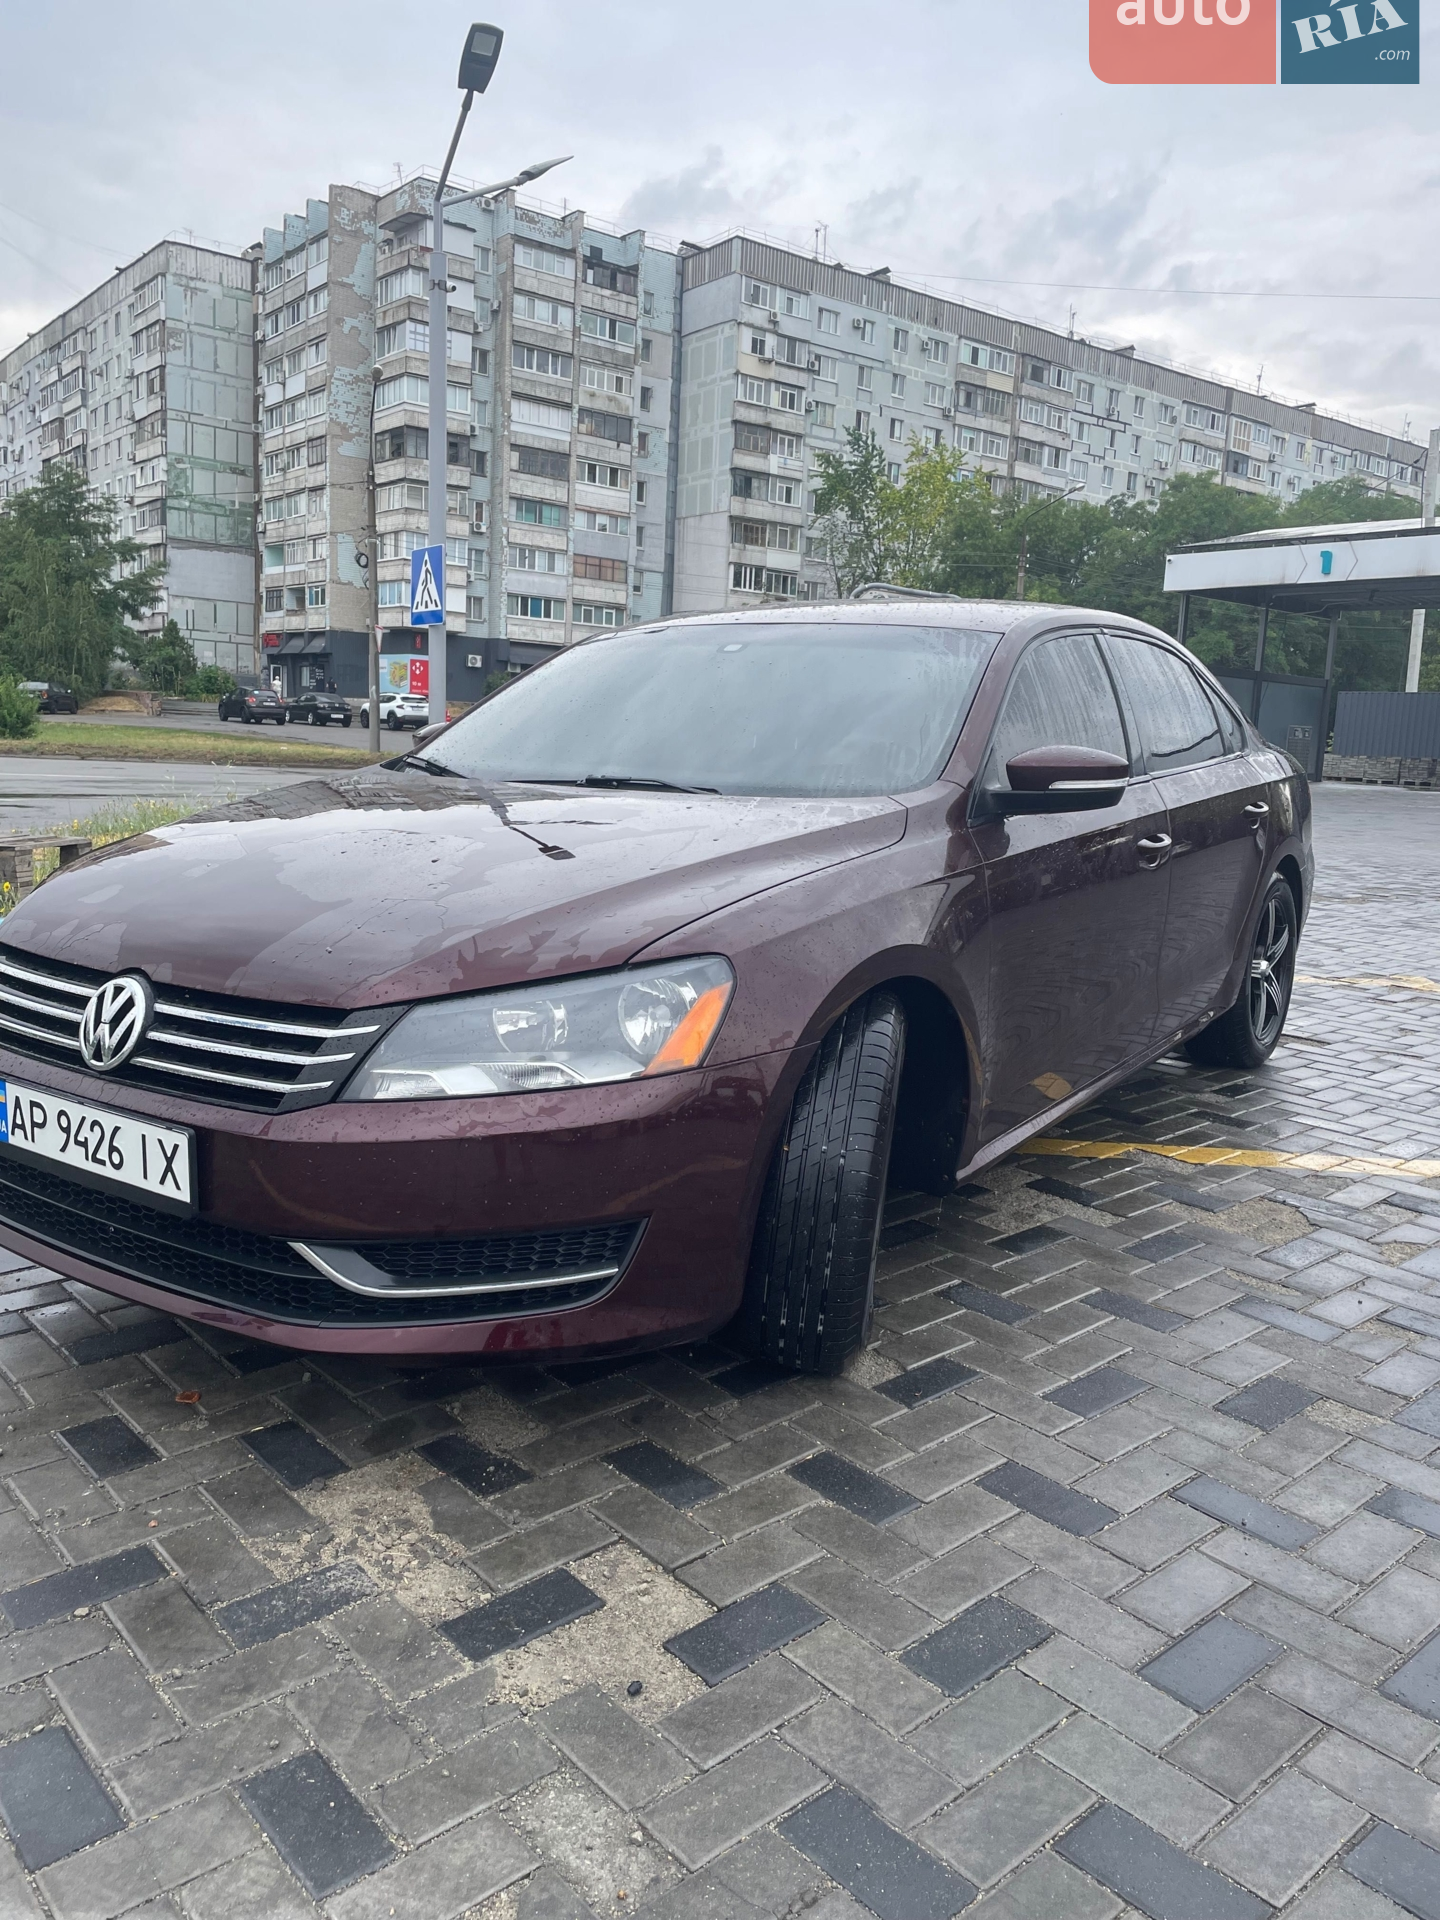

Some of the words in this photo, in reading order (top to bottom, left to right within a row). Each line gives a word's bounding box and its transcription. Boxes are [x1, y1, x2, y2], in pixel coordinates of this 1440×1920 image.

[1320, 550, 1333, 575] 1
[11, 1095, 48, 1143] AP
[56, 1109, 125, 1171] 9426
[141, 1133, 182, 1191] IX
